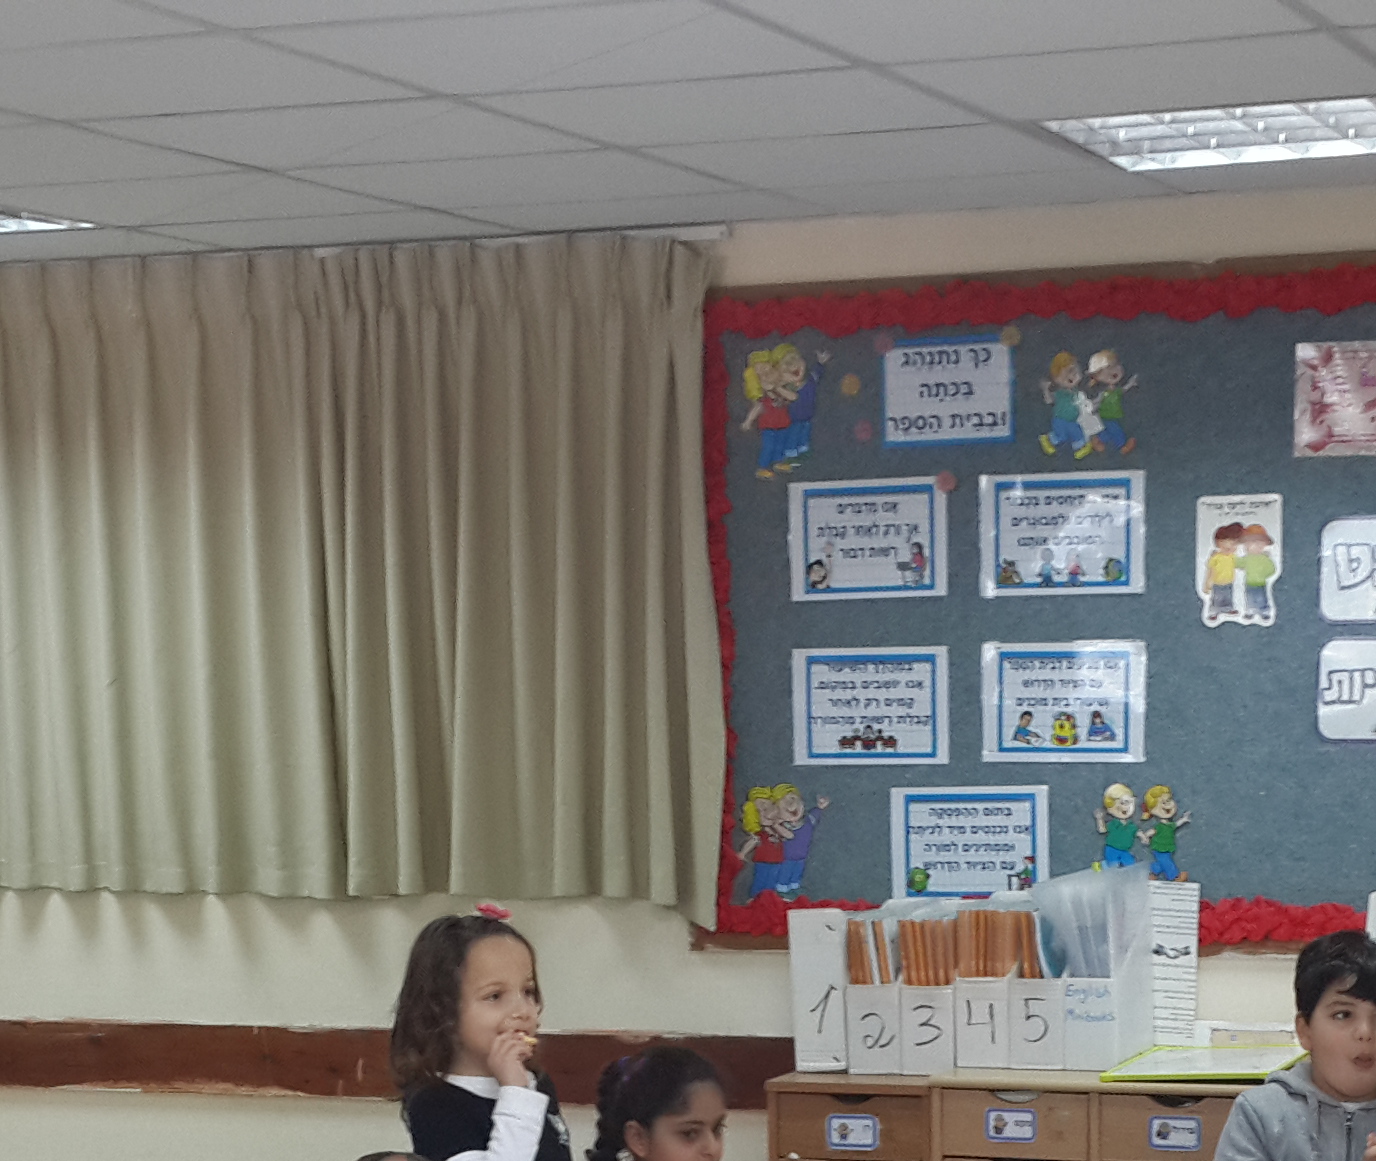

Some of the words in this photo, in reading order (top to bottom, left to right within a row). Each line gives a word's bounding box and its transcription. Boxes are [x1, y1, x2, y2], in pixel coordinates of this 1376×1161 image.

[900, 348, 960, 369] נתנהג
[967, 347, 992, 369] כך
[919, 380, 974, 403] בכתה
[887, 414, 942, 434] הספר
[948, 410, 1006, 431] ובבית
[1065, 983, 1112, 1004] English
[810, 983, 838, 1034] 1
[1022, 996, 1050, 1043] 5
[859, 1011, 897, 1050] 2
[911, 1003, 945, 1047] 3
[965, 998, 998, 1045] 4
